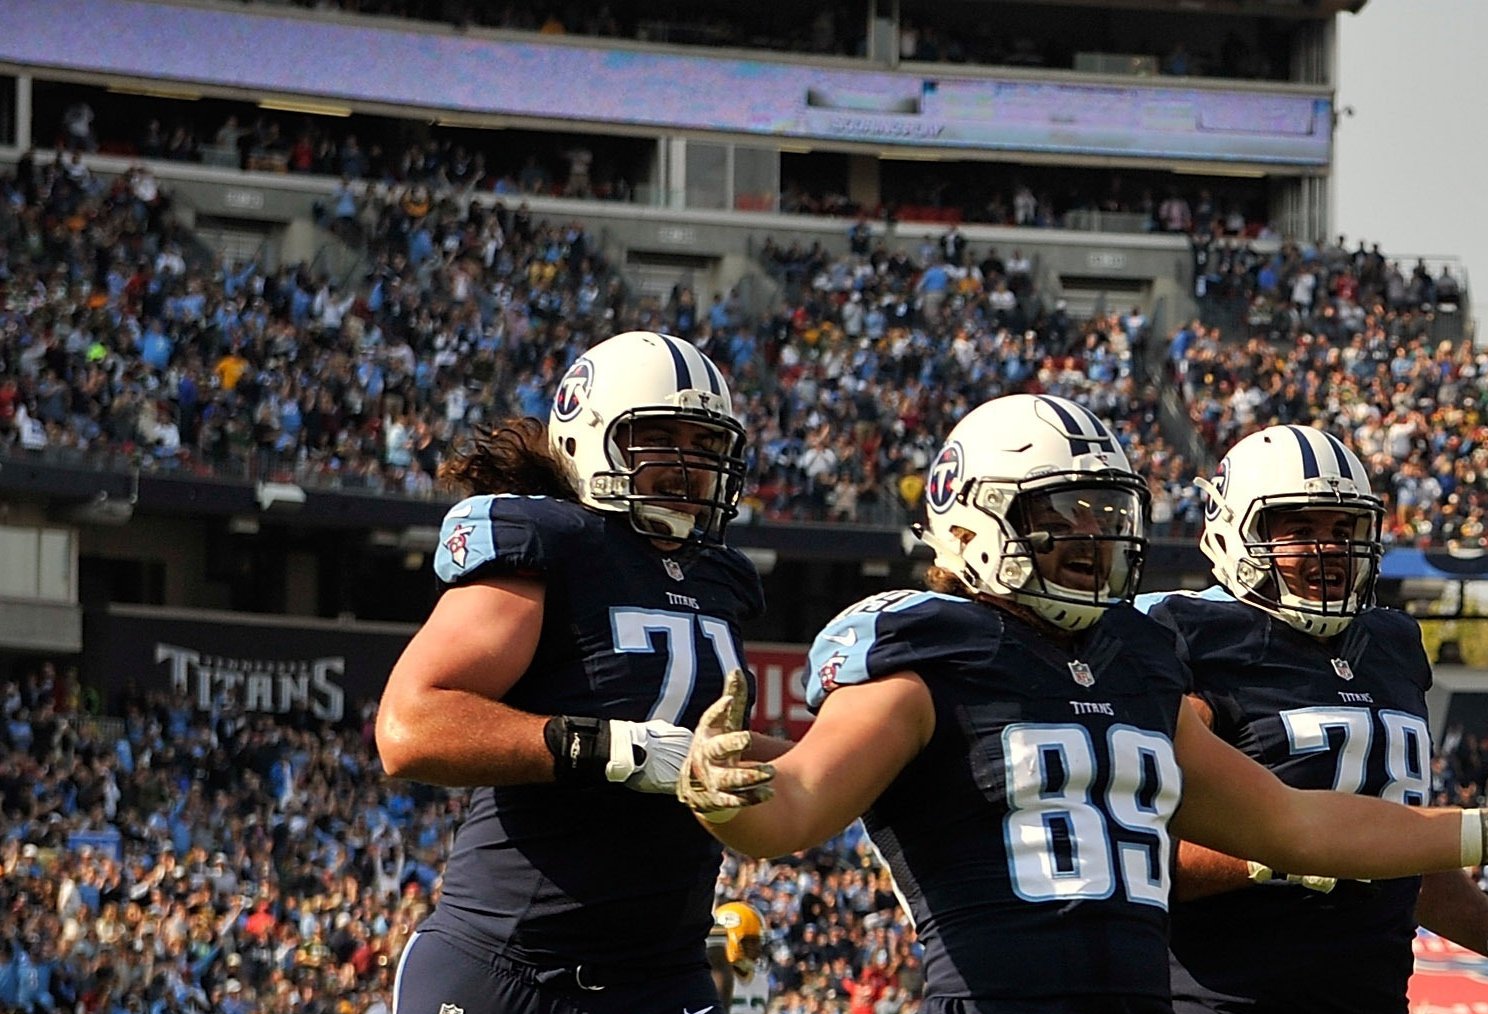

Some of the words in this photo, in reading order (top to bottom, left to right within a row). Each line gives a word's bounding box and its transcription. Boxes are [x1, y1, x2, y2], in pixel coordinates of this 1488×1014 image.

[665, 591, 700, 610] TITANS
[154, 643, 346, 722] TITANS
[609, 606, 742, 726] 71
[1338, 691, 1374, 704] TITANS
[1069, 700, 1115, 716] TITANS
[1279, 705, 1431, 808] 78
[1001, 722, 1184, 913] 89
